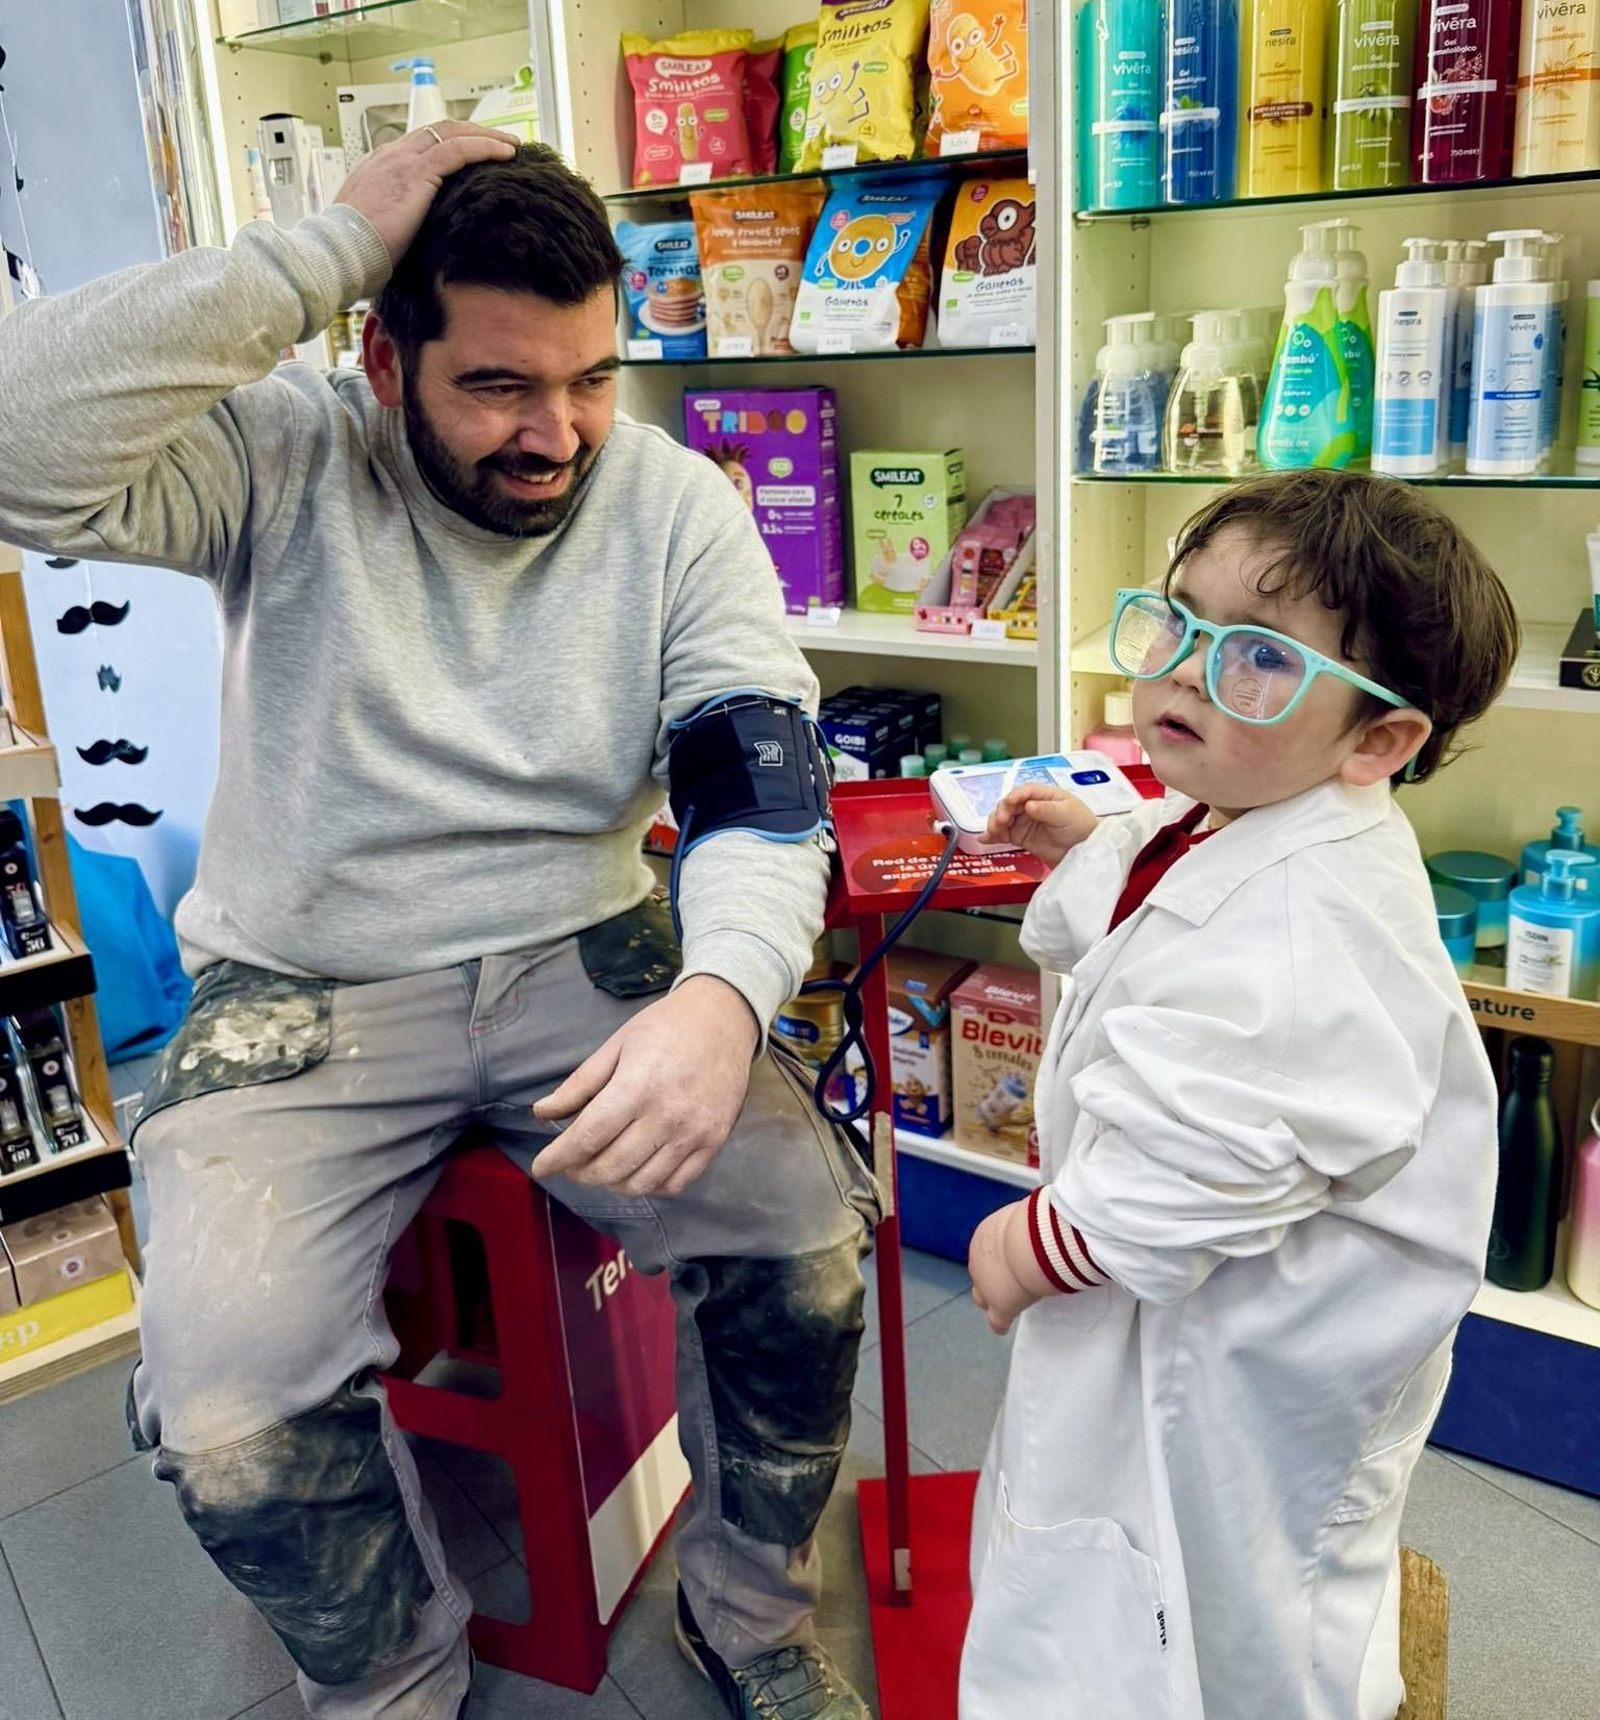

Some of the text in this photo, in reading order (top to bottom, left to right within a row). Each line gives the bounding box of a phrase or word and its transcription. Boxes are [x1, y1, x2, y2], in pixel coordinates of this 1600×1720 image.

[820, 18, 892, 48] Smilitos
[660, 61, 708, 71] SMILEAT
[649, 74, 721, 93] Smilitos
[735, 211, 775, 219] SMILEAT
[648, 265, 701, 277] Tortitas
[975, 277, 1024, 293] Galletas
[825, 296, 868, 307] Galletas
[873, 471, 921, 483] SMILEAT
[893, 494, 903, 509] 7
[874, 510, 925, 522] cereales
[835, 734, 866, 746] GOIBI
[872, 857, 905, 867] Red
[907, 855, 928, 864] de
[965, 857, 993, 868] red
[949, 868, 969, 876] en
[971, 864, 1017, 875] salud
[983, 985, 1037, 1002] Blevit
[1469, 998, 1535, 1021] ature
[962, 1016, 1043, 1056] Blevit
[985, 1049, 1034, 1071] cereales
